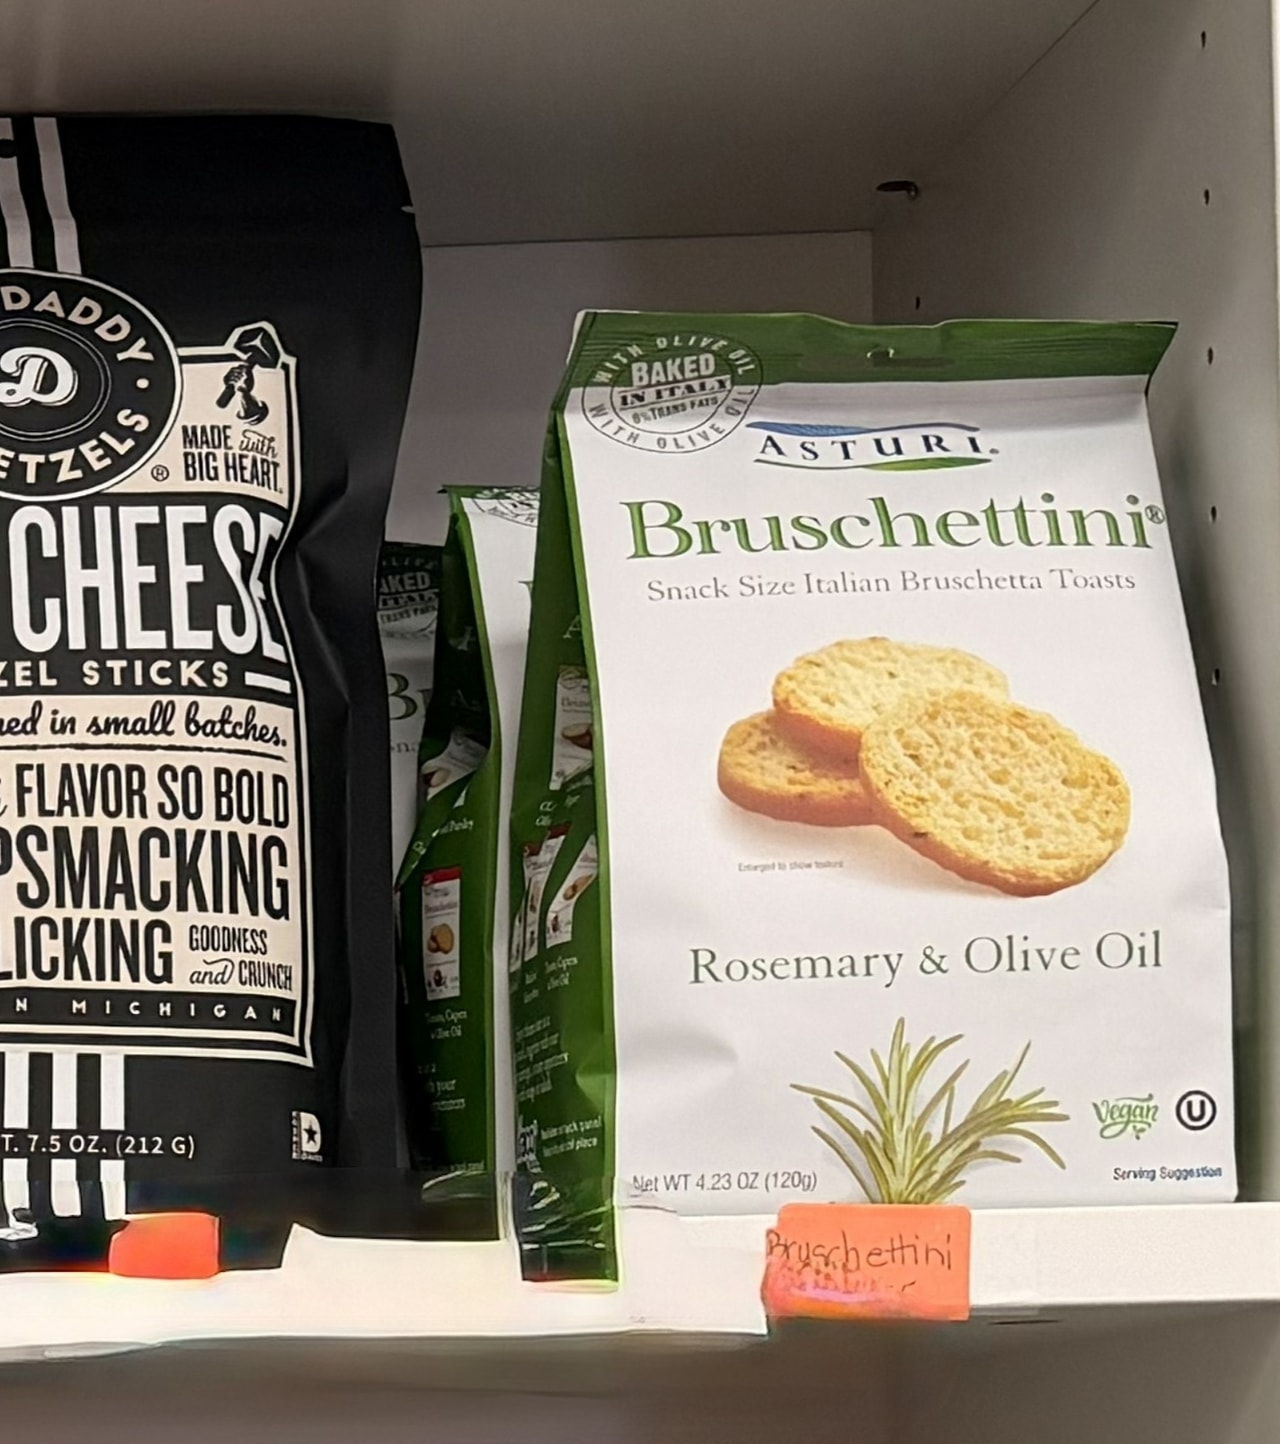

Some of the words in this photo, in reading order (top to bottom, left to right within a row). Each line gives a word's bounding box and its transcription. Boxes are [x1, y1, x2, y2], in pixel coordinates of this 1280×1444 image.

[0, 285, 155, 365] DADDY
[631, 352, 715, 387] BAKED
[619, 390, 645, 407] IN
[653, 378, 729, 399] ITALY
[647, 577, 728, 602] Snack
[737, 575, 795, 598] Size
[805, 572, 891, 594] Italian
[901, 566, 1041, 594] Bruschetta
[1049, 566, 1136, 591] Toasts
[83, 661, 229, 688] STICKS
[50, 710, 76, 735] in
[86, 701, 174, 737] small
[184, 702, 288, 747] batches.
[16, 763, 148, 819] FLAVOR
[157, 764, 201, 821] SO
[214, 767, 290, 829] BOLD
[688, 945, 904, 988] Rosemary
[919, 945, 949, 974] &
[964, 935, 1080, 973] Olive
[1096, 930, 1164, 970] Oil
[73, 1001, 281, 1022] MICHIGAN
[1090, 1096, 1159, 1140] Vegan
